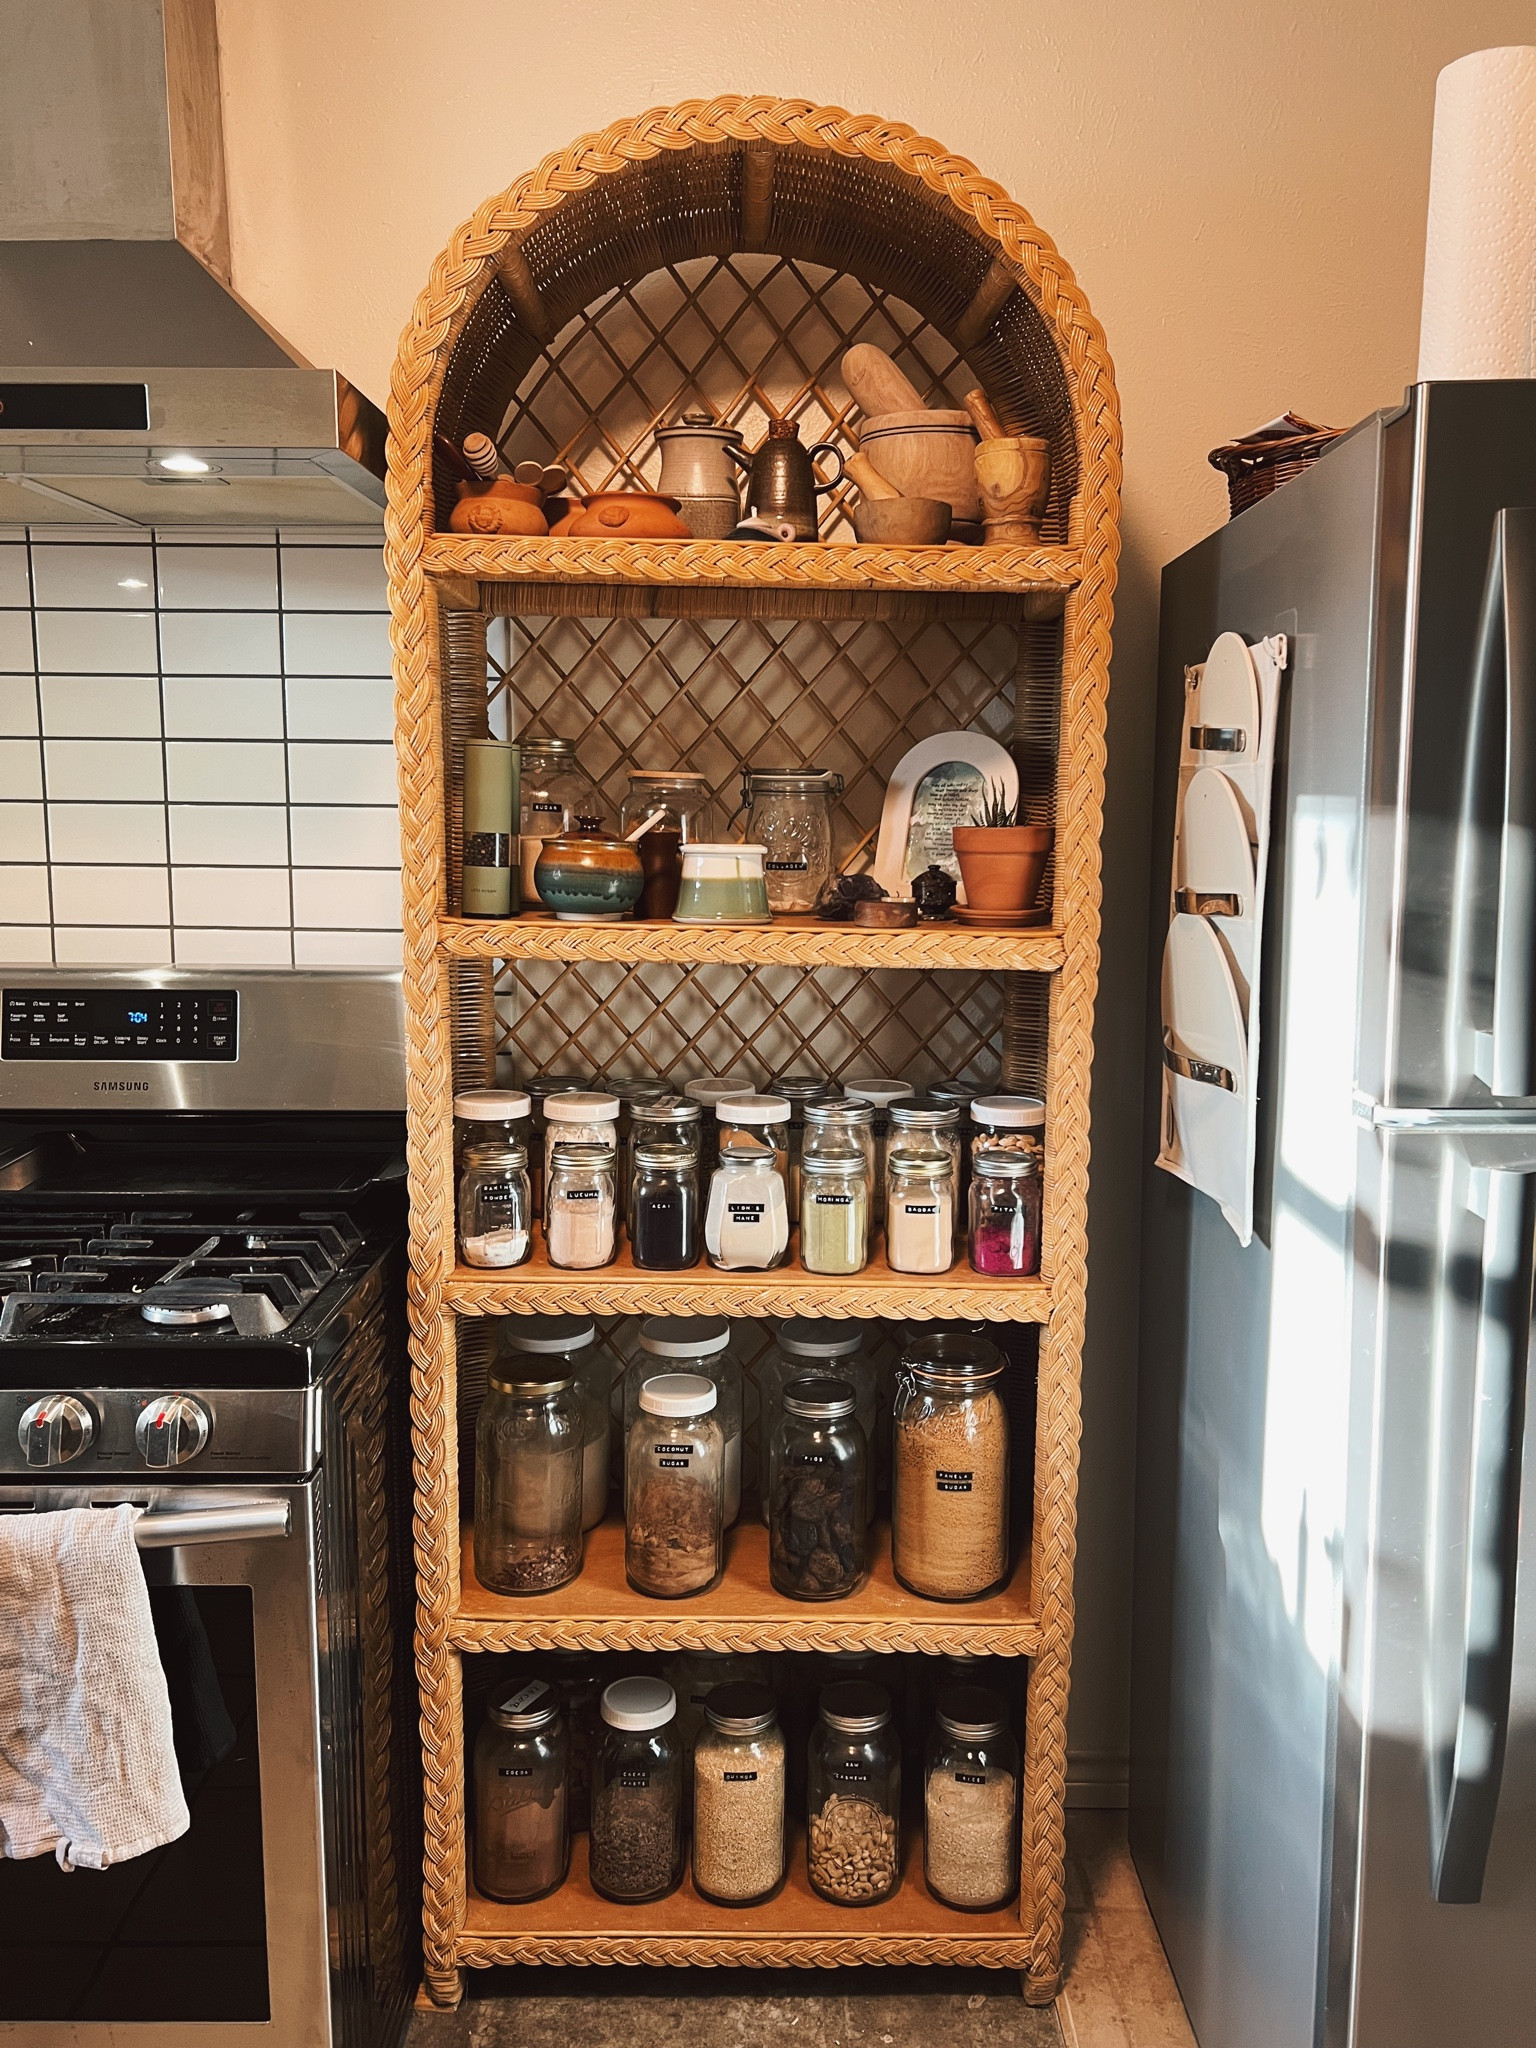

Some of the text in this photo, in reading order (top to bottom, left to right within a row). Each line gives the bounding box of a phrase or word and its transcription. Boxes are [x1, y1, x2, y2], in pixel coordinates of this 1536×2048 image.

[93, 1081, 149, 1091] SAMSUNG
[569, 1191, 599, 1199] LUCUMA
[835, 1773, 867, 1781] CASHEWS
